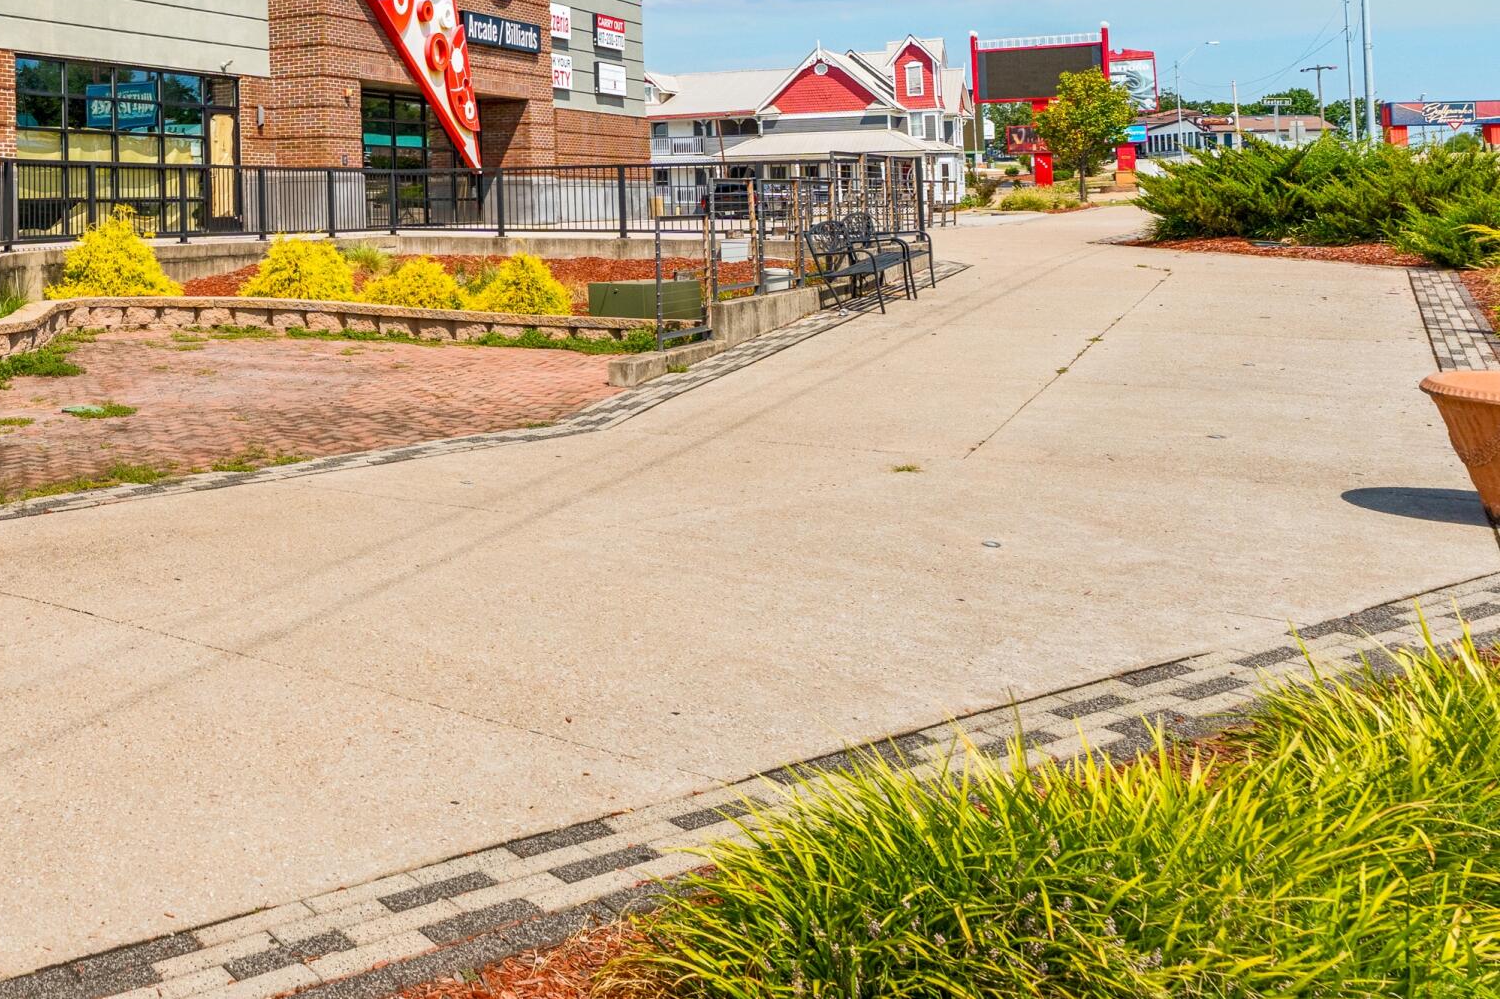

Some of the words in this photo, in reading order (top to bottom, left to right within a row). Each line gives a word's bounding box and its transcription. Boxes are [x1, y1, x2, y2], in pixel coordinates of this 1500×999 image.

[468, 14, 498, 42] Arcade
[505, 21, 538, 50] Billiards
[598, 17, 613, 29] CARRY
[614, 21, 623, 31] OUT
